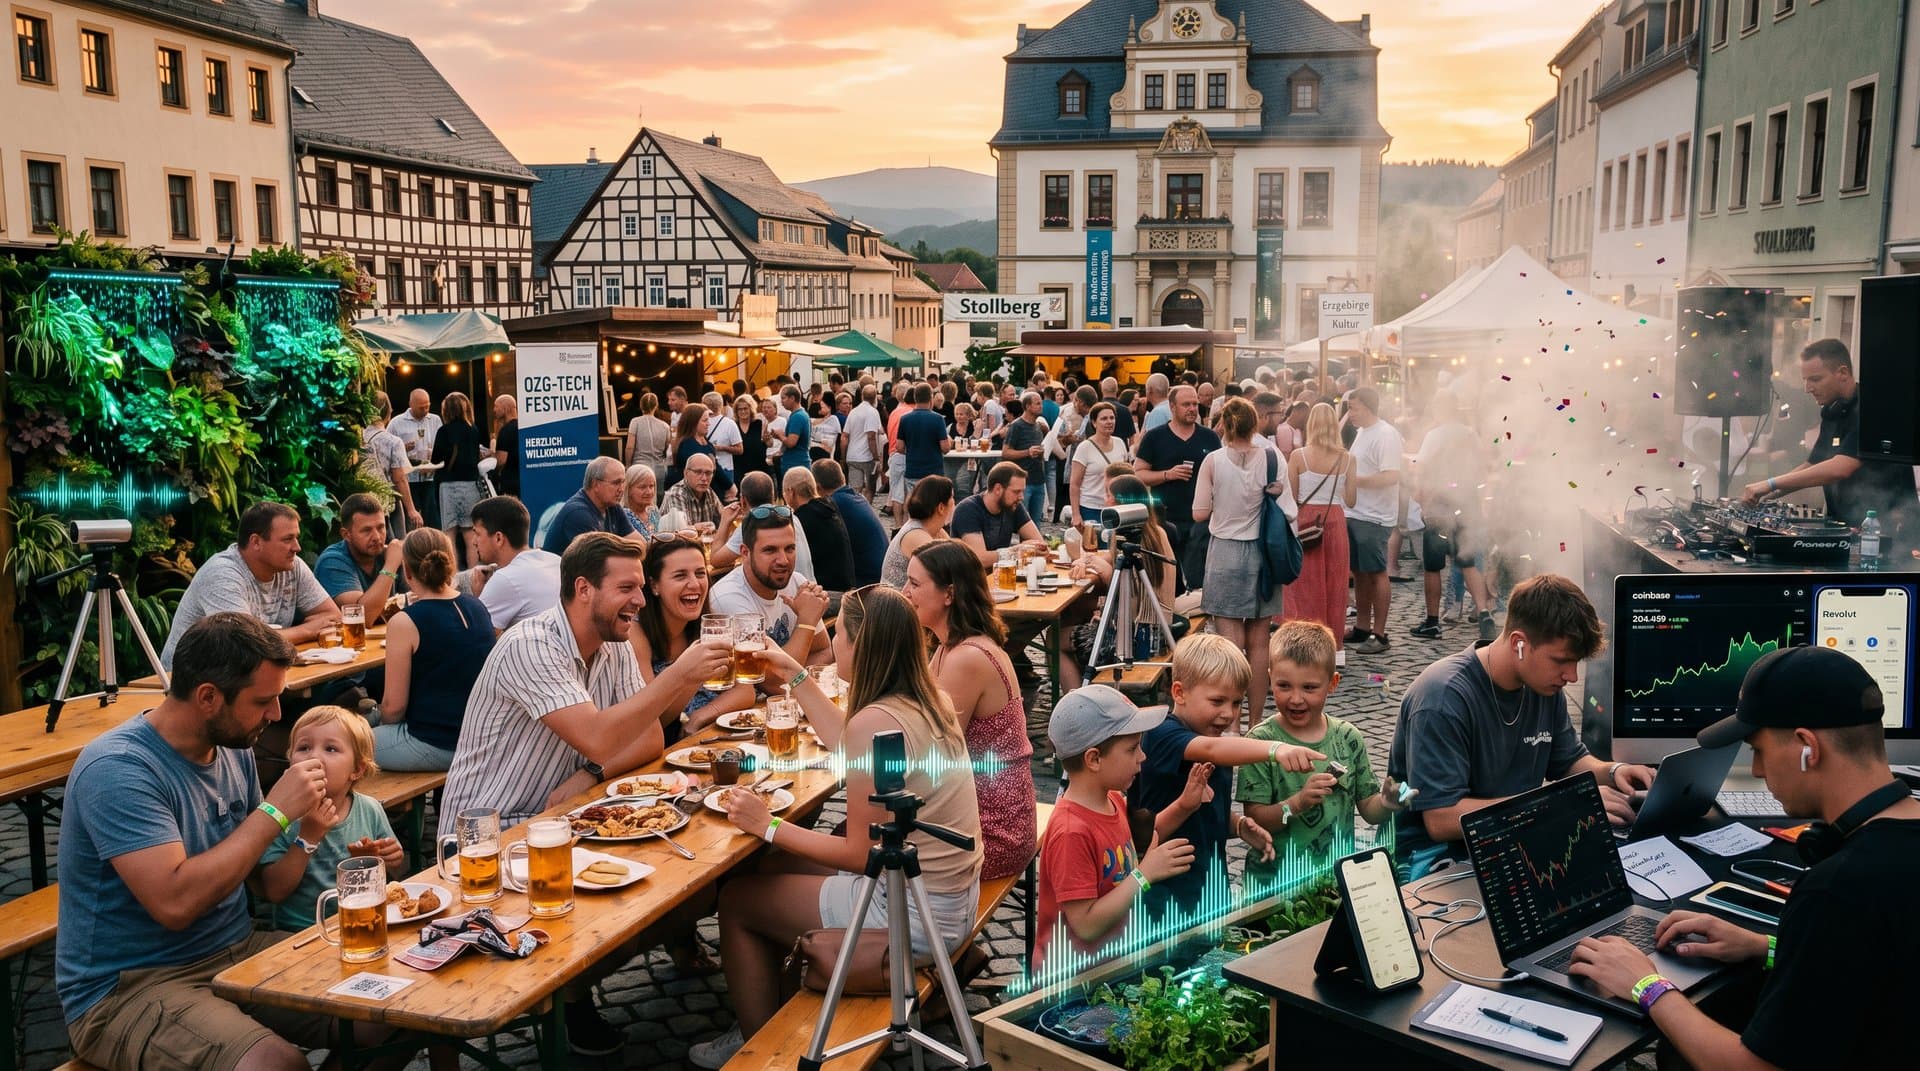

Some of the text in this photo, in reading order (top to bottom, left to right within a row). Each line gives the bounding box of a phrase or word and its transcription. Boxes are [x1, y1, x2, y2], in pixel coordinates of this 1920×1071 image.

[960, 298, 1041, 319] Stollberg
[1322, 300, 1369, 312] Erzgebirge
[1332, 319, 1360, 329] Kultur
[524, 375, 592, 392] OZG-TECH
[525, 395, 589, 413] FESTIVAL
[525, 436, 562, 448] HERZLICH
[525, 446, 578, 459] WILLKOMMEN
[1793, 540, 1837, 548] Pioneer
[1632, 591, 1671, 600] coinbase
[1822, 610, 1857, 618] Revolut
